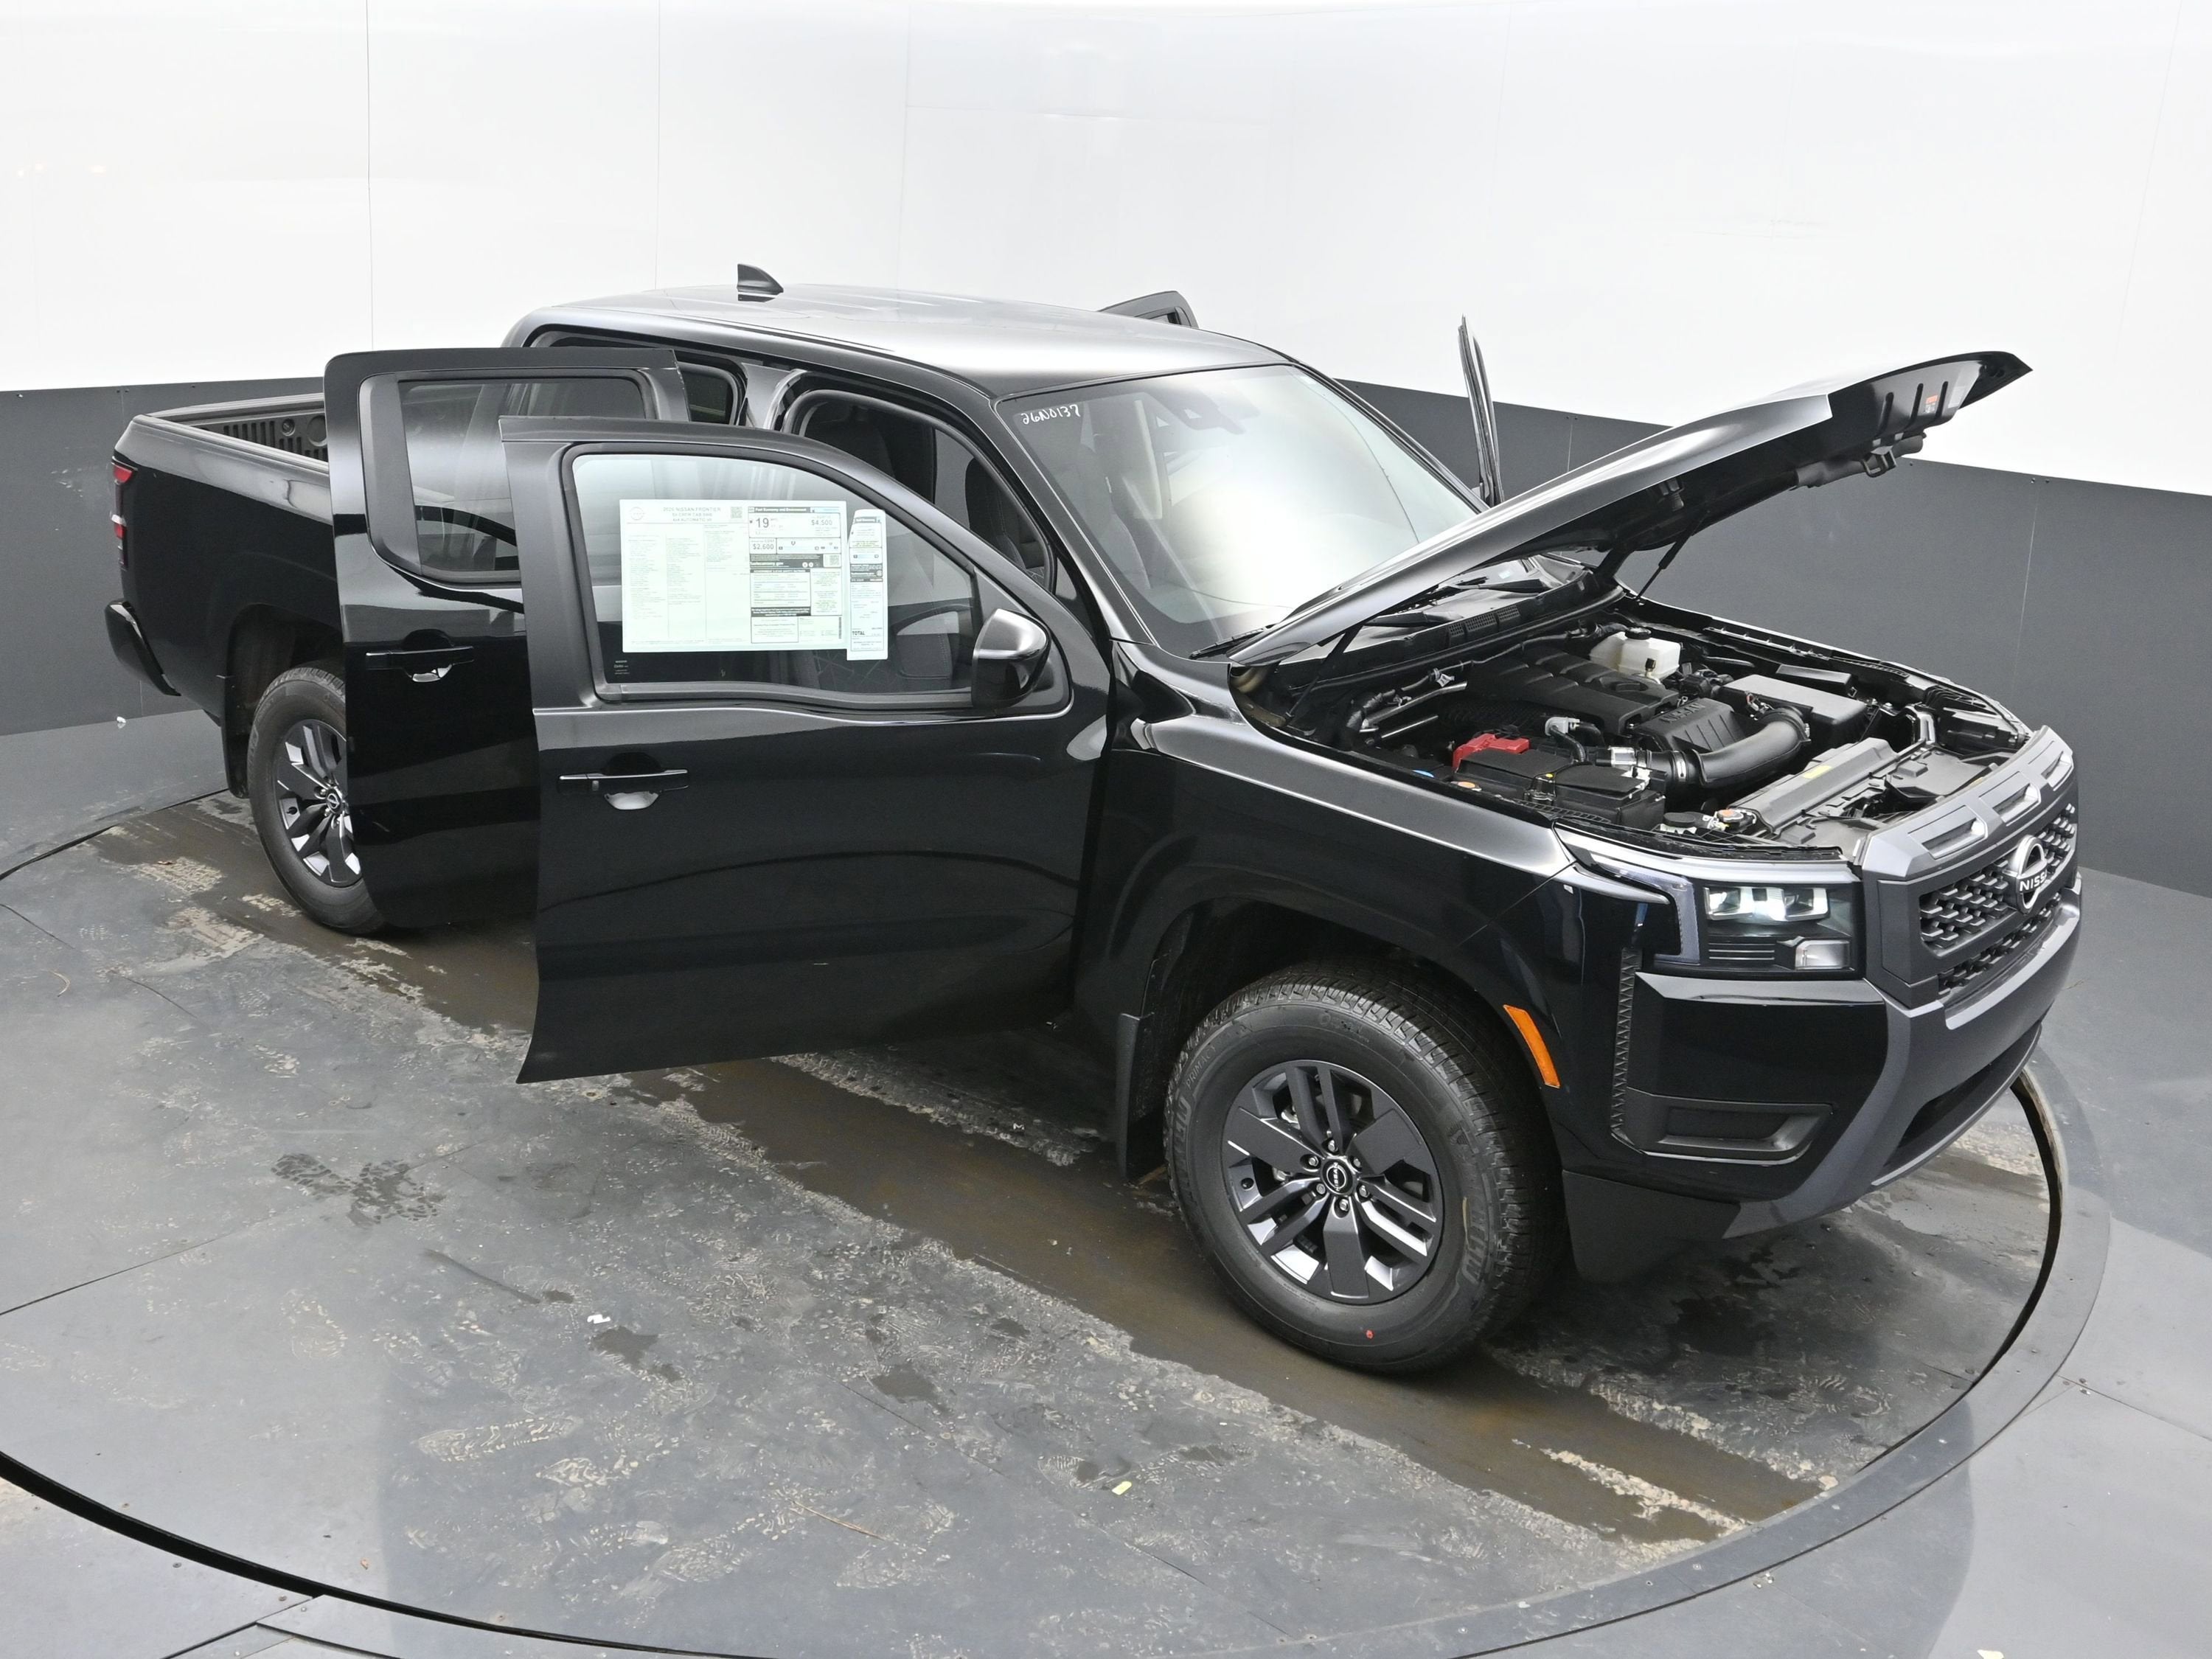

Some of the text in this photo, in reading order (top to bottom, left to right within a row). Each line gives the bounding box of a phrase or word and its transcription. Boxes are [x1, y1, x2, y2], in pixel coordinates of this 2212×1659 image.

[1021, 404, 1080, 424] 26N0137
[756, 518, 769, 529] 19
[2020, 869, 2047, 891] NISS
